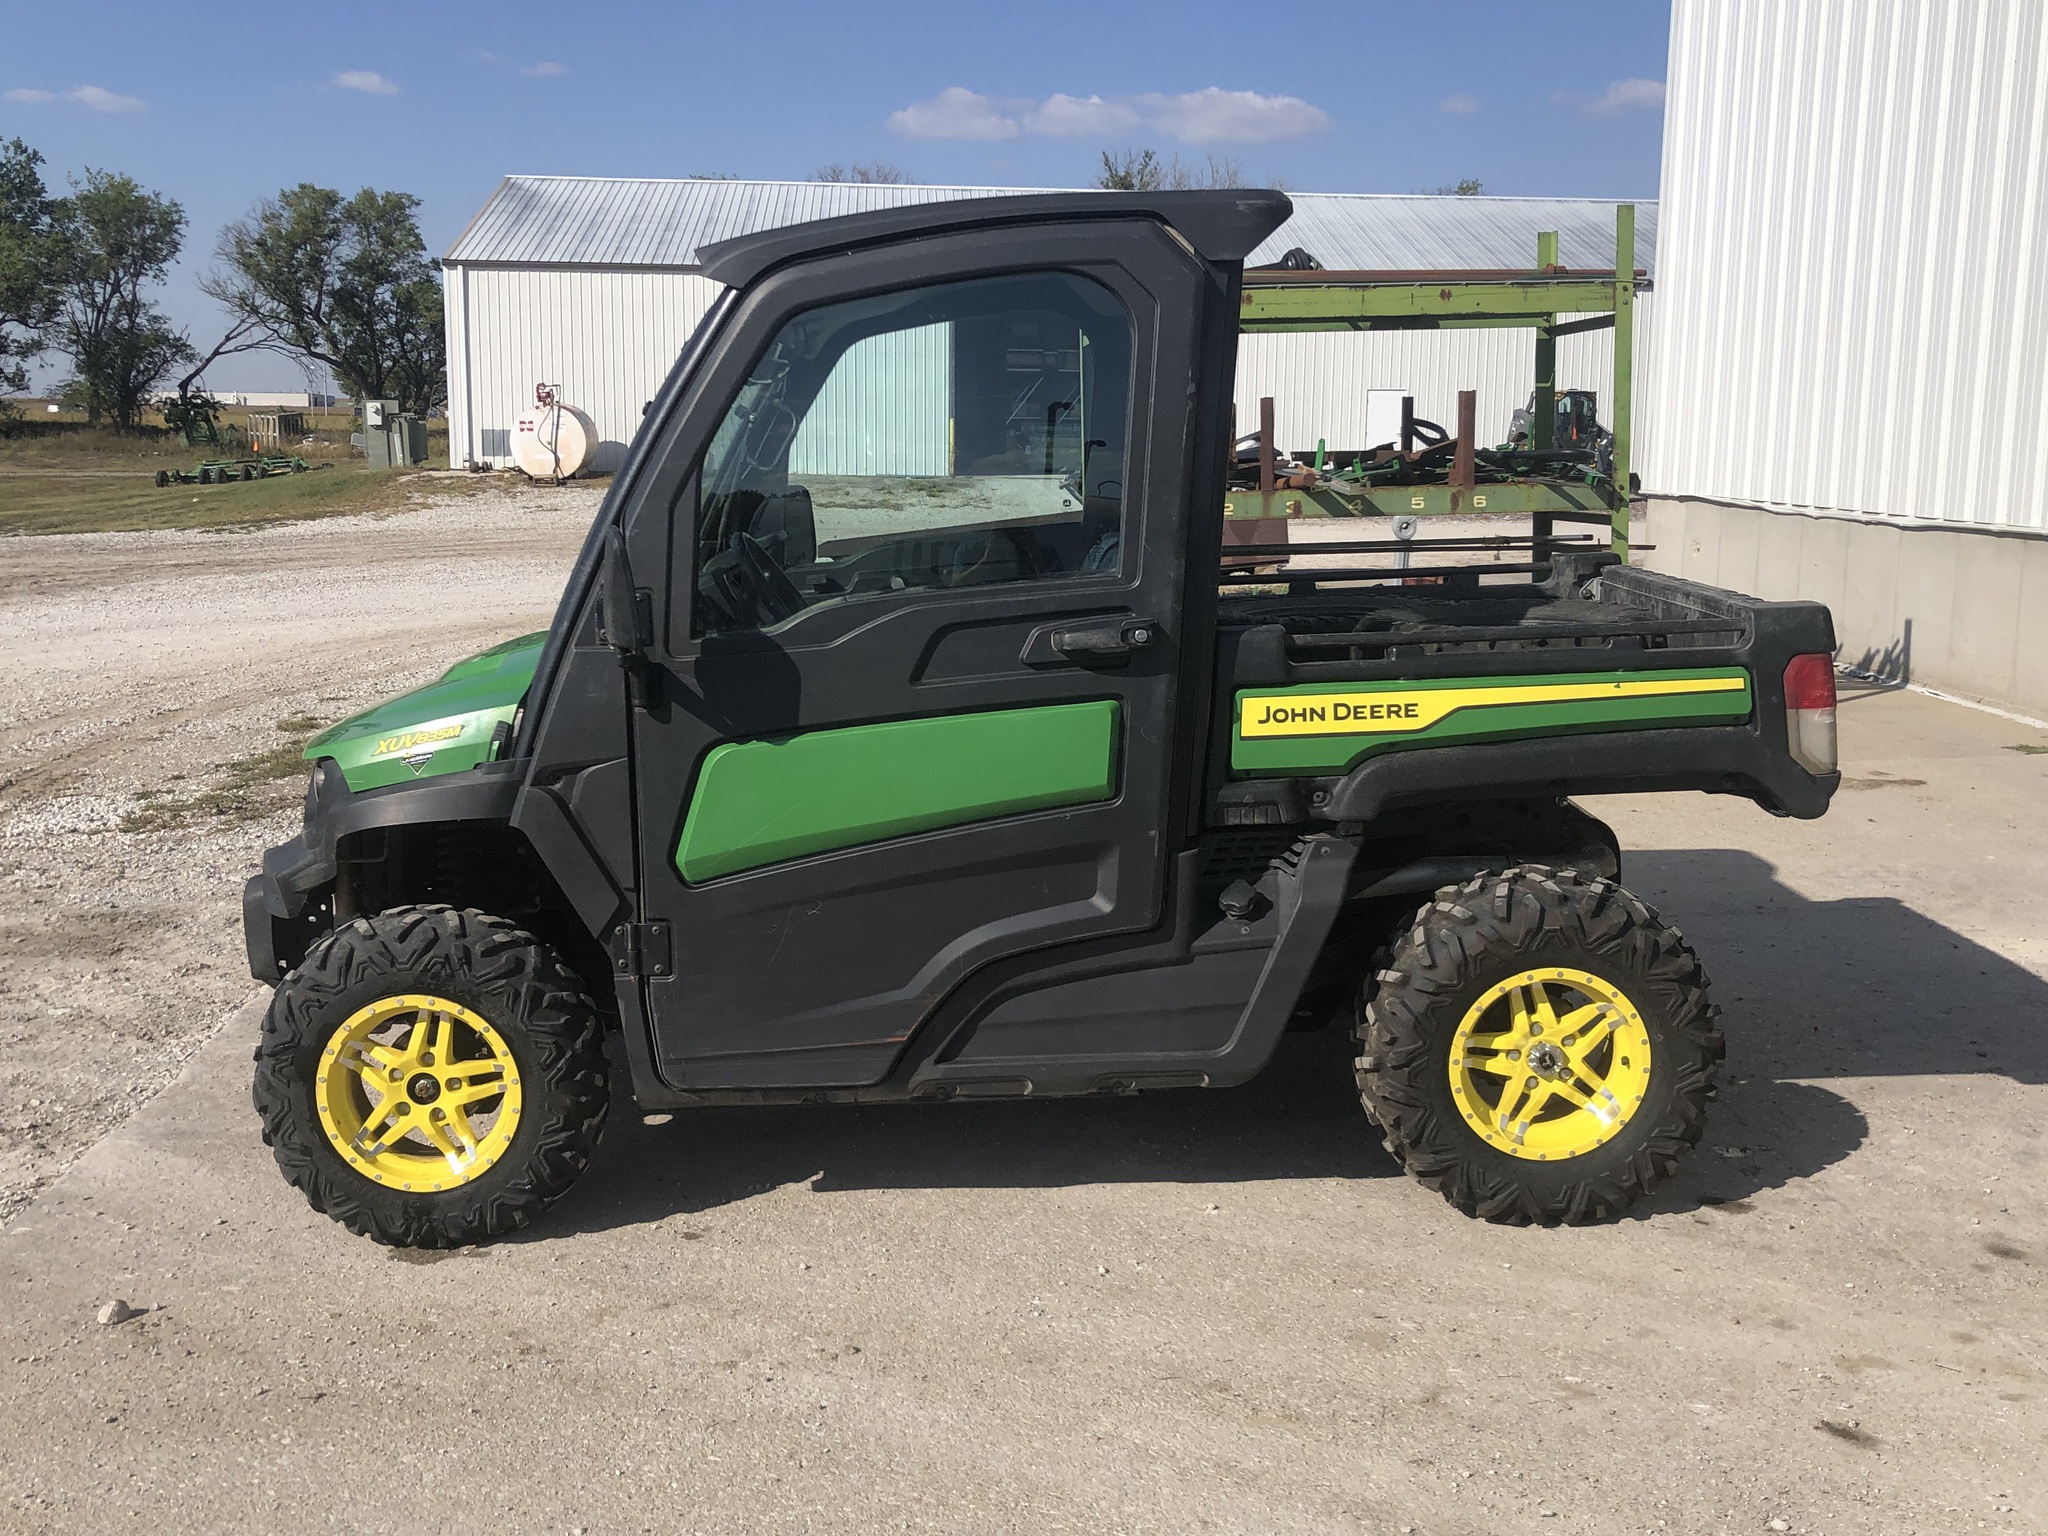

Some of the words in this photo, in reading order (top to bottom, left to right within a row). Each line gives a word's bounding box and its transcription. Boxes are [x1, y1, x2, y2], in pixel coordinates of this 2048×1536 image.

[1411, 497, 1425, 509] 5
[1473, 495, 1487, 508] 6
[1257, 705, 1326, 725] JOHN
[1333, 702, 1419, 721] DEERE
[372, 725, 464, 756] XUV835M
